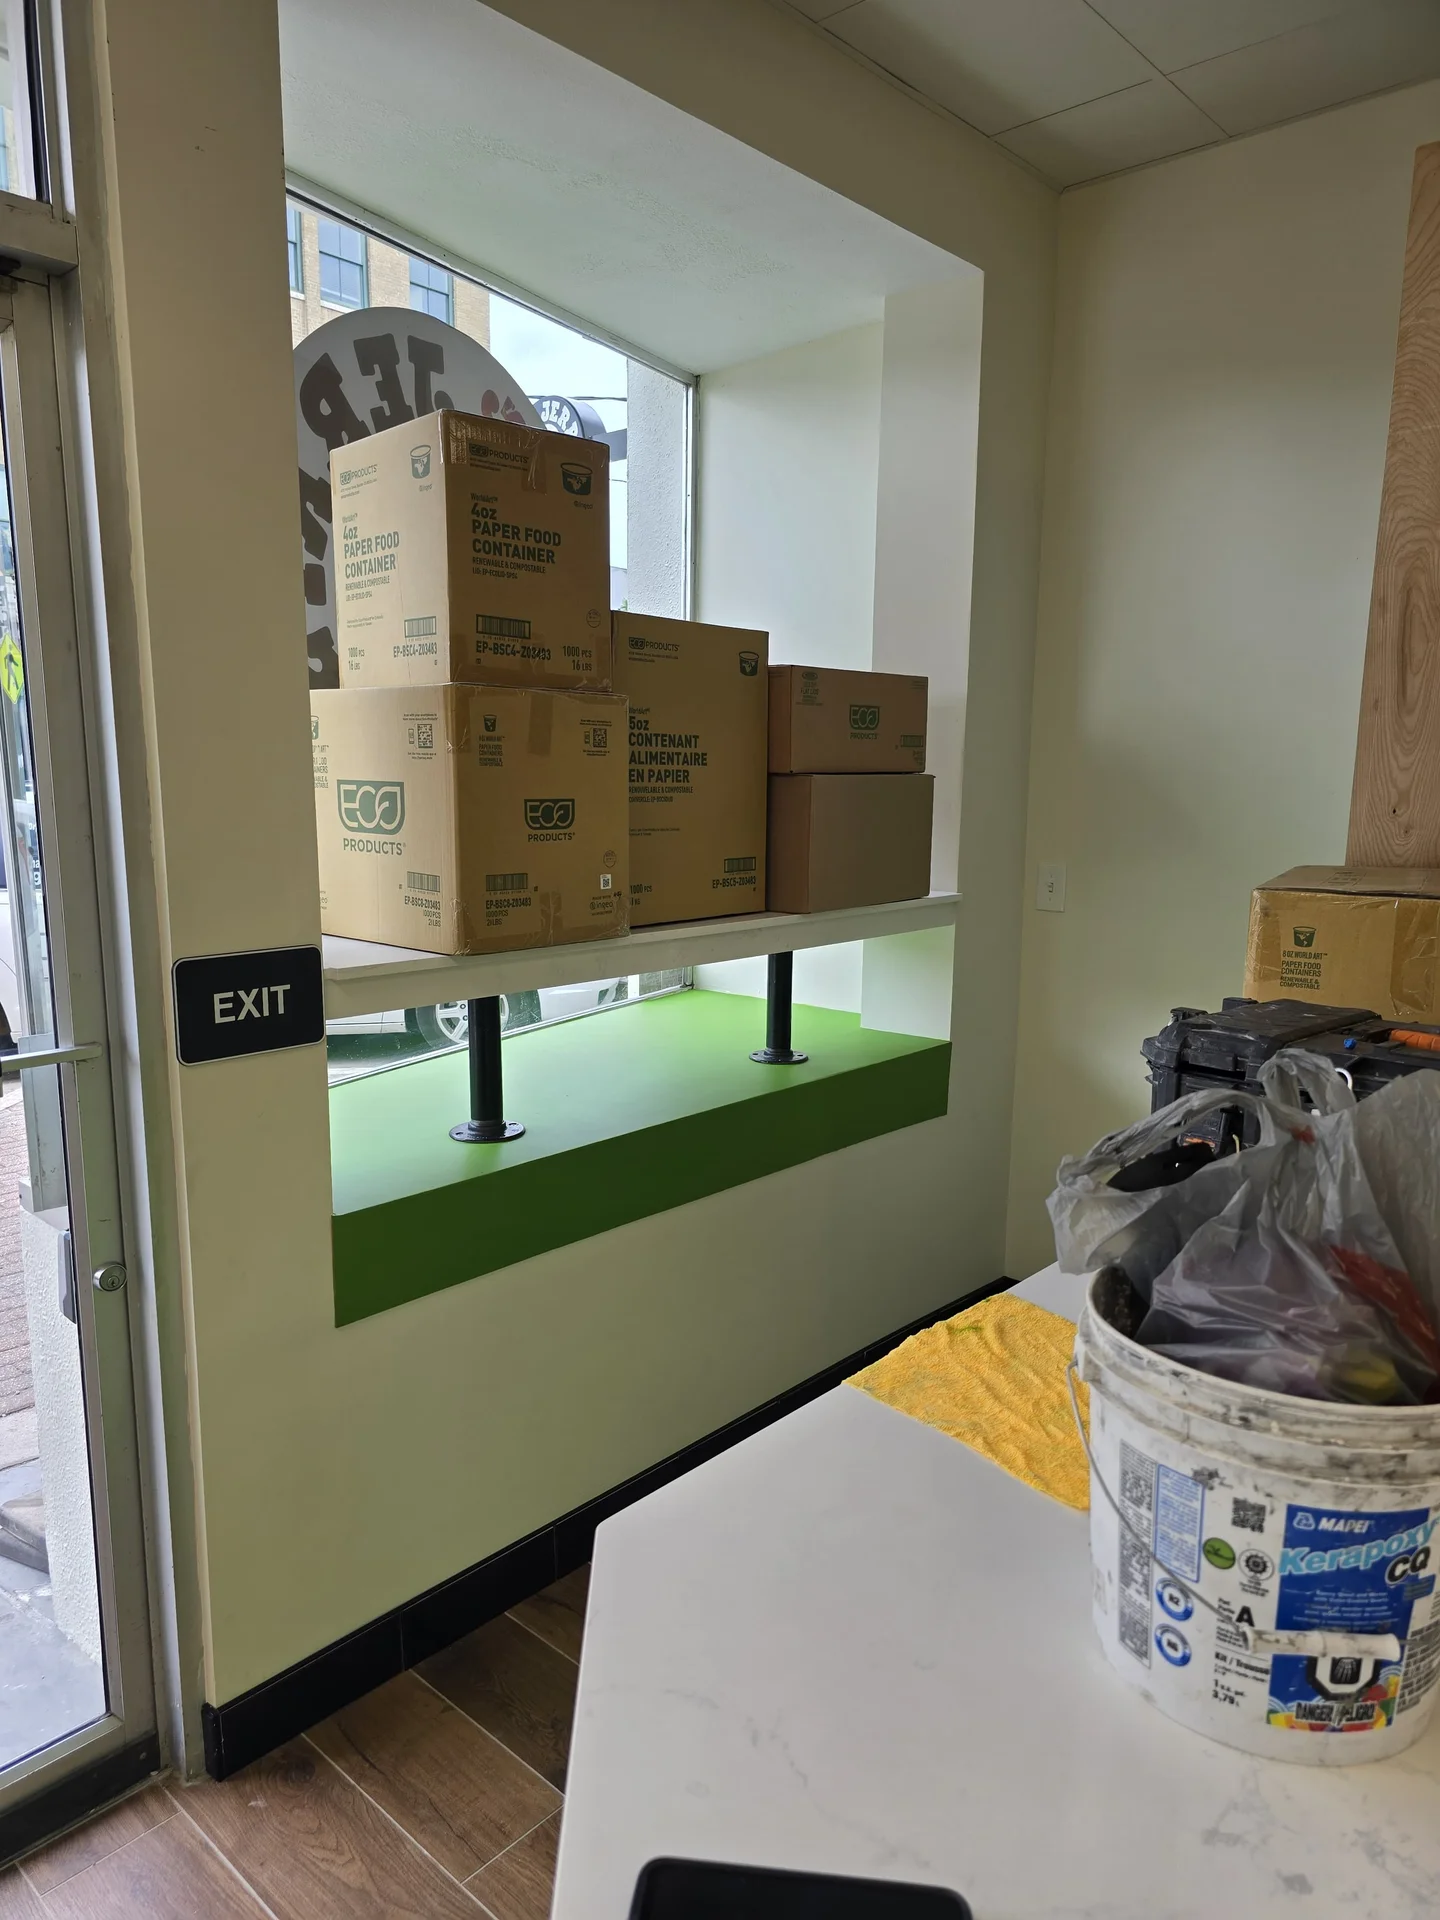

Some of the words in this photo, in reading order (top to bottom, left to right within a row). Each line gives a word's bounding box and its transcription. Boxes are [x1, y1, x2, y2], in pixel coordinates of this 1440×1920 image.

[472, 519, 521, 540] PAPER
[524, 527, 561, 547] FOOD
[344, 538, 373, 559] PAPER
[375, 531, 400, 552] FOOD
[472, 538, 555, 564] CONTAINER
[345, 553, 396, 579] CONTAINER
[472, 556, 504, 569] RENEWABLE
[562, 645, 580, 657] 1000
[581, 650, 592, 658] PCS
[645, 640, 680, 652] PRODUCTS
[572, 659, 580, 671] 16
[628, 732, 699, 749] CONTENANT
[628, 750, 708, 767] ALIMENTAIRE
[628, 768, 645, 783] EN
[647, 769, 690, 784] PAPIER
[340, 784, 401, 830] ECO
[527, 801, 573, 828] ECO
[527, 832, 573, 843] PRODUCTS
[343, 837, 403, 856] PRODUCTS
[1282, 949, 1287, 958] 8
[1287, 950, 1294, 958] OZ
[1294, 951, 1313, 960] WORLD
[1280, 967, 1322, 978] CONTAINERS
[1281, 960, 1303, 969] PAPER
[1303, 961, 1322, 970] FOOD
[1279, 981, 1320, 990] COMPOSTABLE
[1280, 975, 1314, 984] RENEWABLE
[213, 984, 291, 1024] EXIT
[1318, 1517, 1370, 1533] MAPEI
[1277, 1516, 1439, 1576] Kerapoxy
[1386, 1546, 1432, 1584] CQ
[1235, 1605, 1255, 1628] A
[1215, 1651, 1227, 1663] Kit
